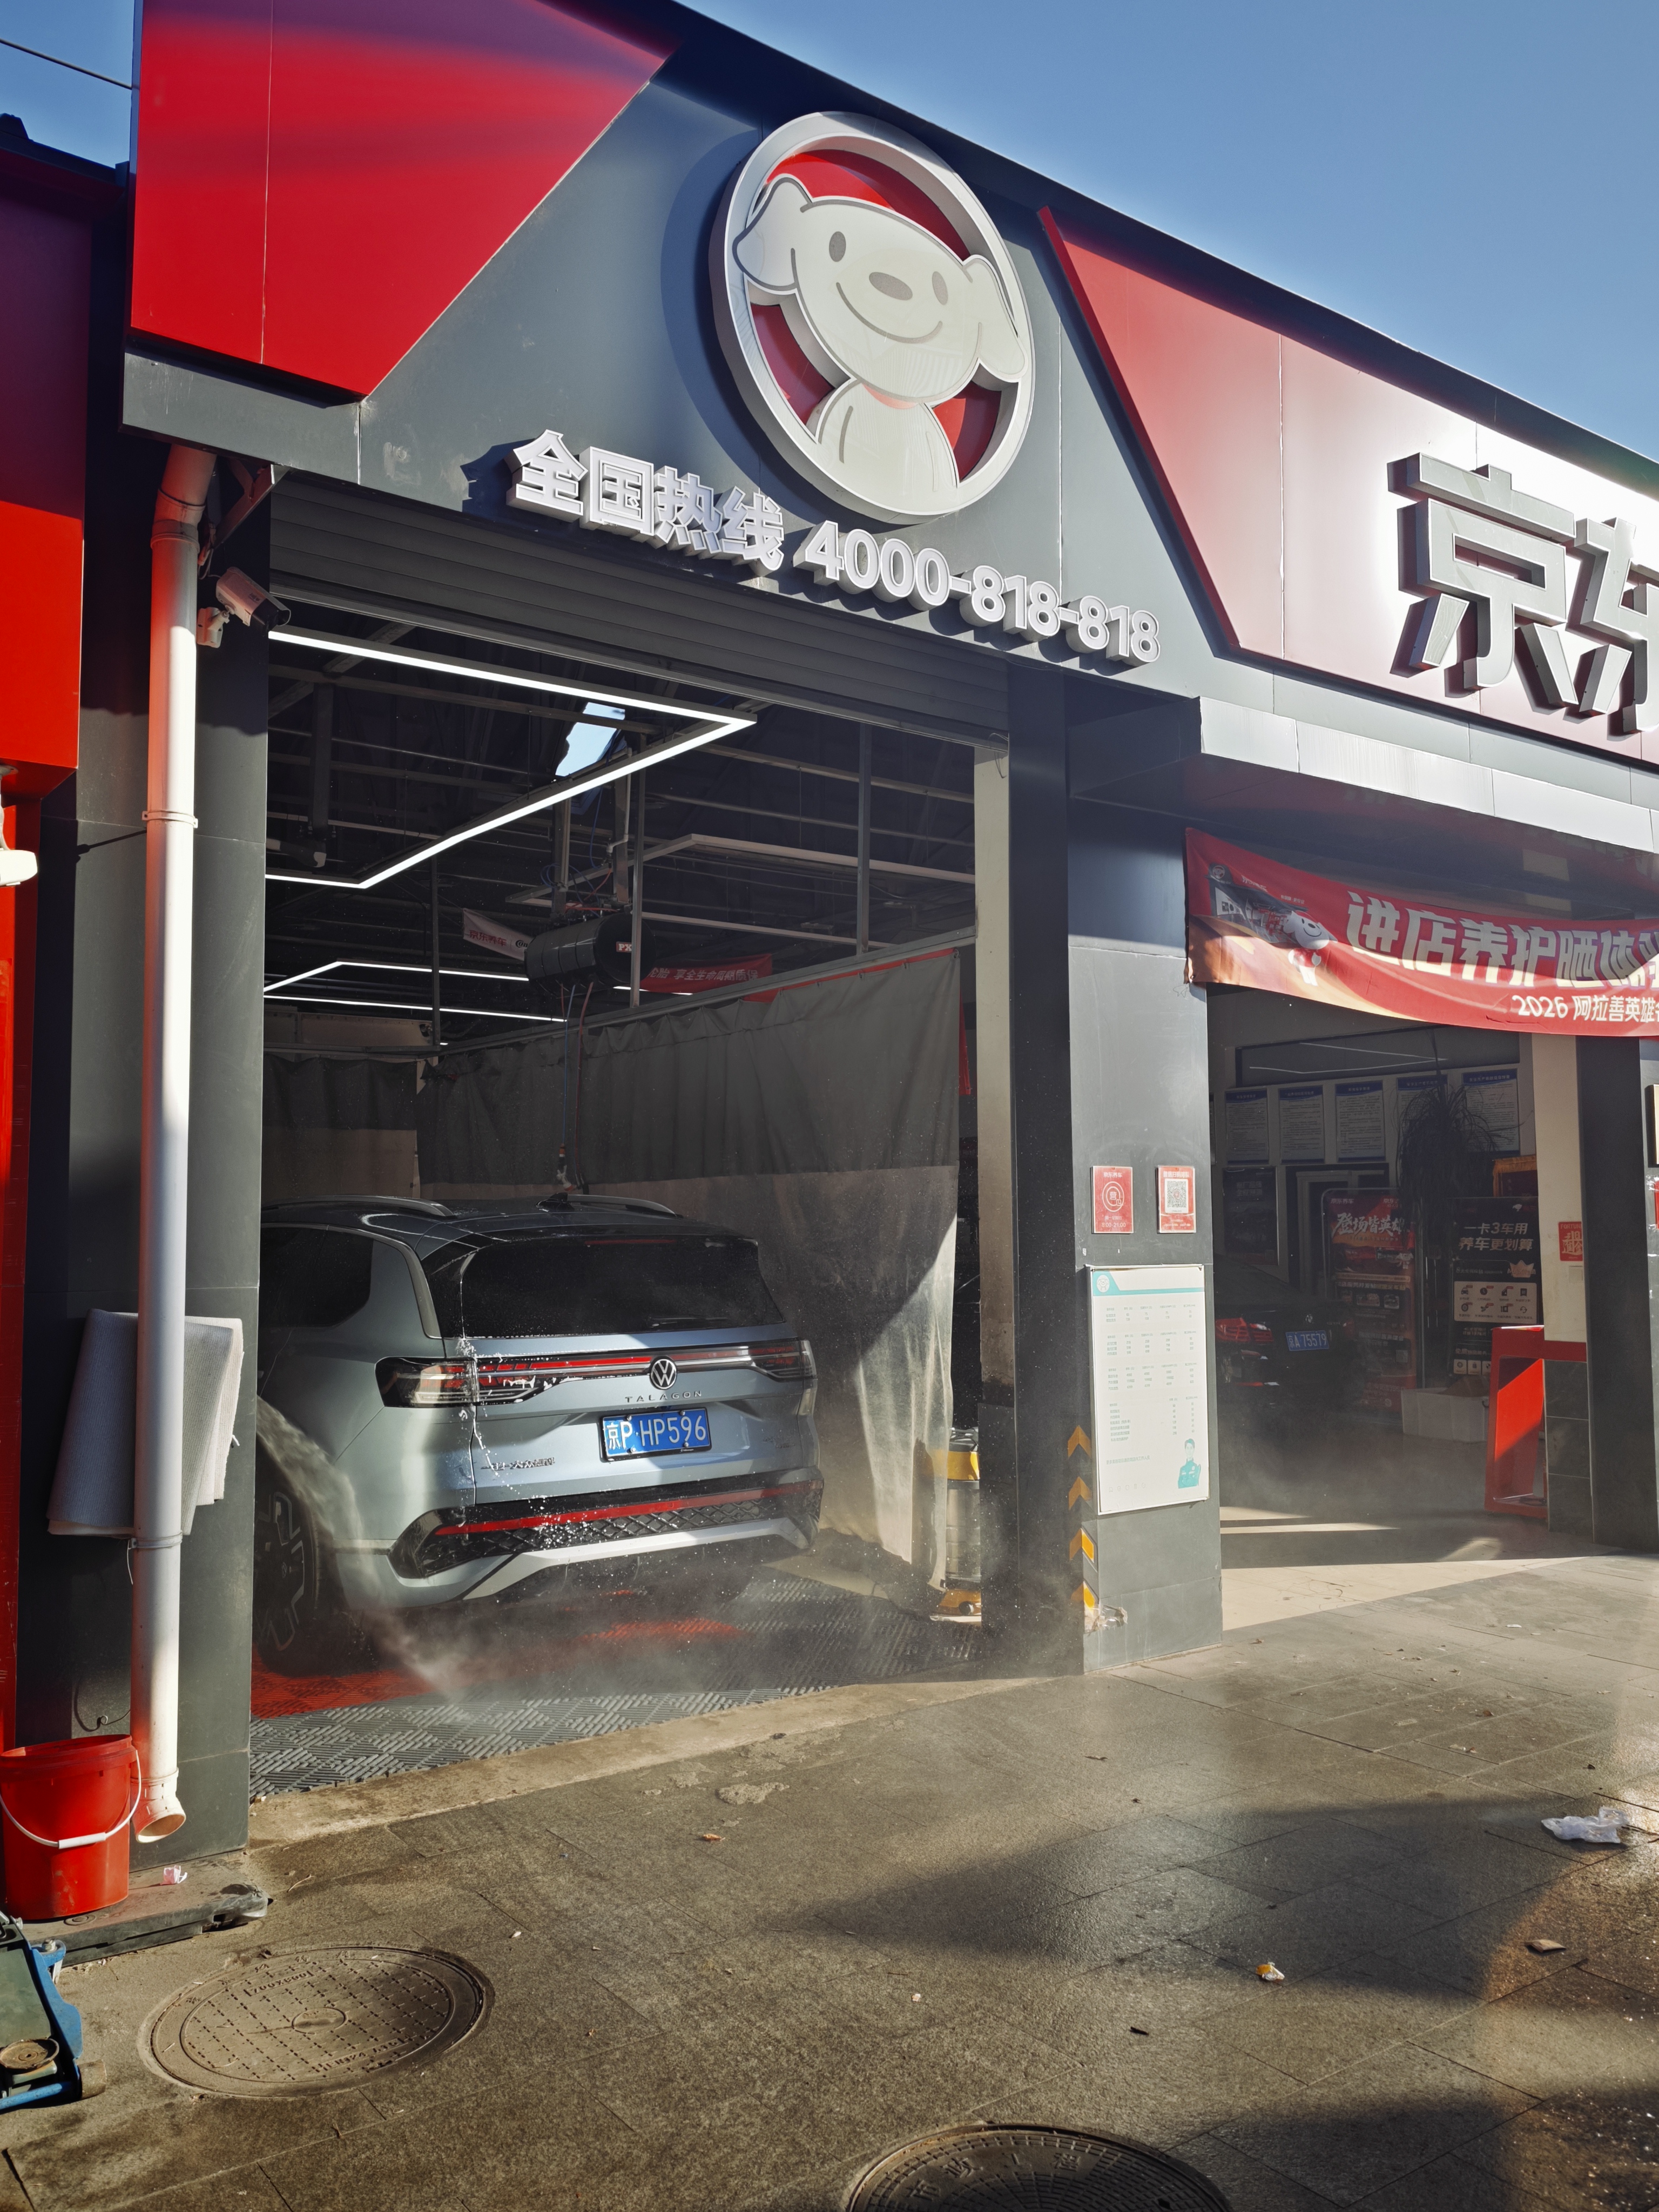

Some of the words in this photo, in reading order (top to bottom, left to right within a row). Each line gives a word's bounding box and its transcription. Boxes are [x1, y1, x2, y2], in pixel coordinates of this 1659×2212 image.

[504, 429, 784, 575] 全国热线
[796, 521, 1160, 664] 4000-818-818
[469, 930, 507, 947] 京东养车
[1512, 995, 1569, 1019] 2026
[1571, 995, 1659, 1023] 阿拉善英雄
[1464, 1222, 1528, 1235] 一卡3车用
[1459, 1237, 1533, 1251] 养车更划算
[625, 1391, 702, 1402] TALAGON
